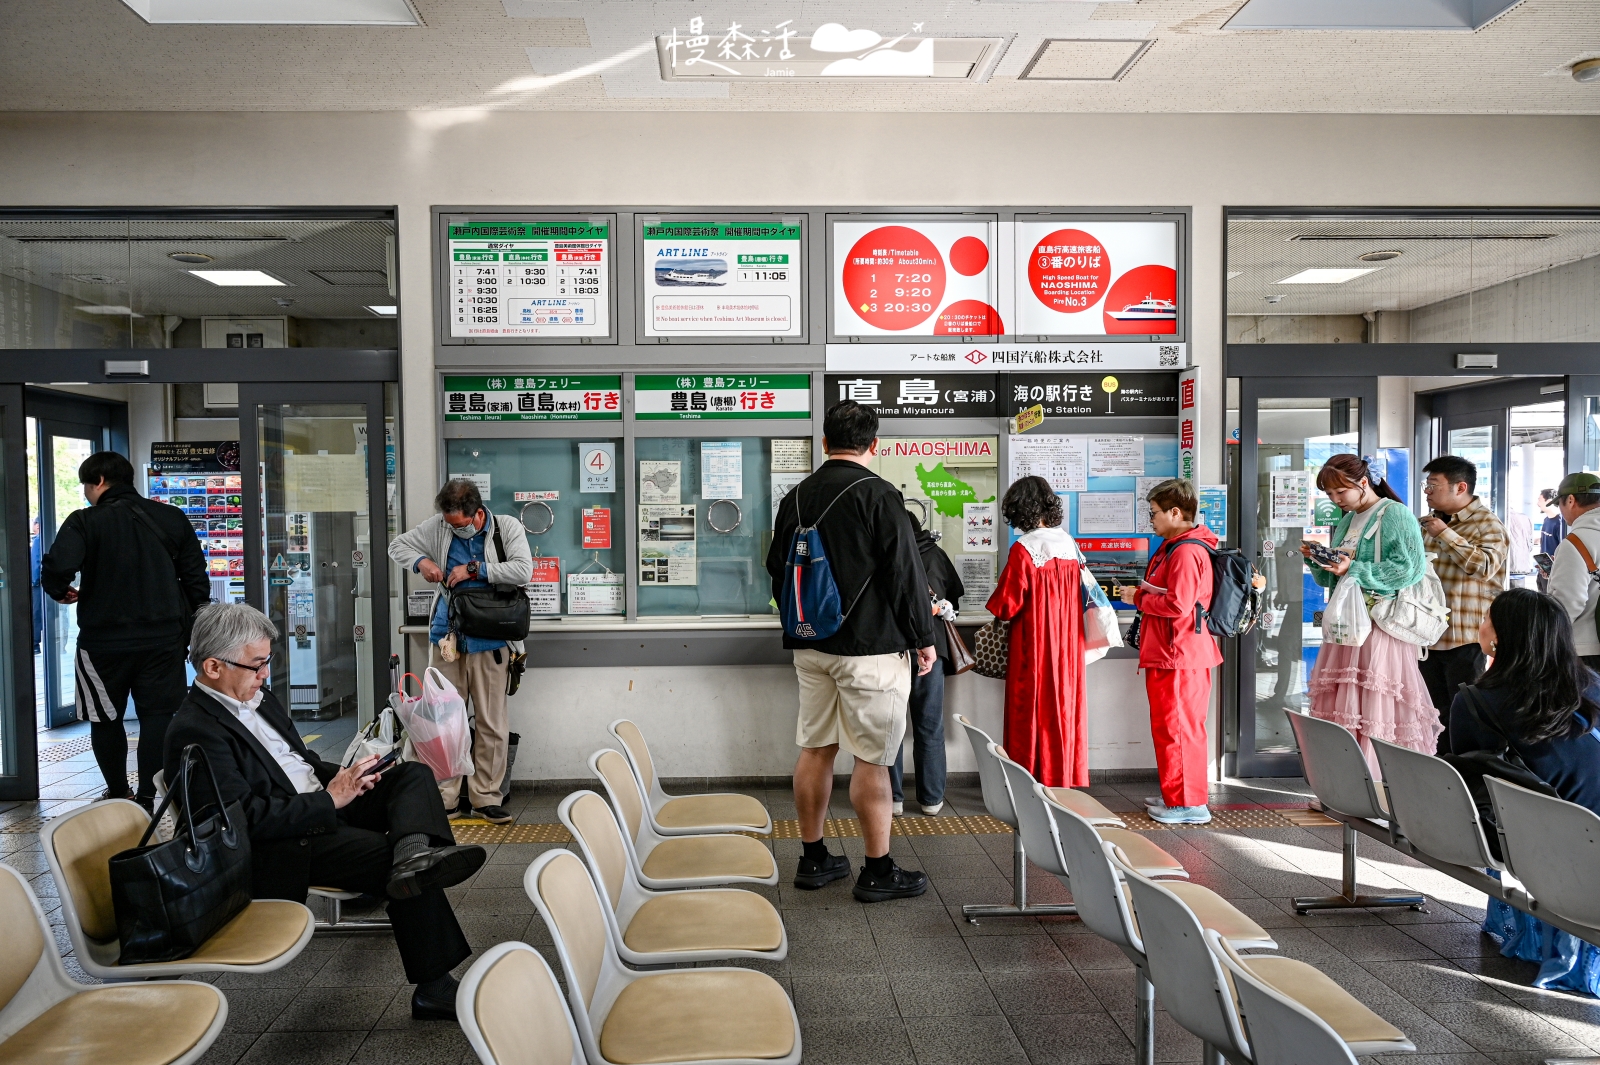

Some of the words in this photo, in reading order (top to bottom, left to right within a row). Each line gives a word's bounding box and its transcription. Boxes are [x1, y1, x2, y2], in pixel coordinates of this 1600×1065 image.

[453, 226, 526, 236] 瀬戸内国際芸術祭
[532, 226, 603, 236] 開催期間中ダイヤ
[647, 227, 719, 236] 瀬戸内国際芸術祭
[725, 227, 795, 236] 開催期間中ダイヤ
[755, 272, 786, 280] 11:05
[871, 274, 876, 282] 1
[895, 274, 931, 282] 7:20
[870, 289, 877, 298] 2
[895, 288, 931, 297] 9:20
[1065, 296, 1086, 306] No.3
[870, 303, 877, 312] 3
[884, 303, 931, 312] 20:30
[910, 353, 956, 361] アートな船旅
[992, 350, 1103, 363] 四国汽船株式会社
[486, 378, 507, 389] (株)
[514, 378, 581, 389] 豊島フェリー
[676, 377, 696, 388] (株)
[703, 377, 769, 388] 豊島フェリー
[944, 390, 996, 403] (宮浦)
[1013, 385, 1093, 402] 海の駅行き
[584, 391, 619, 411] 行き
[740, 391, 776, 410] 行き
[881, 446, 892, 456] of
[895, 442, 992, 456] NAOSHIMA
